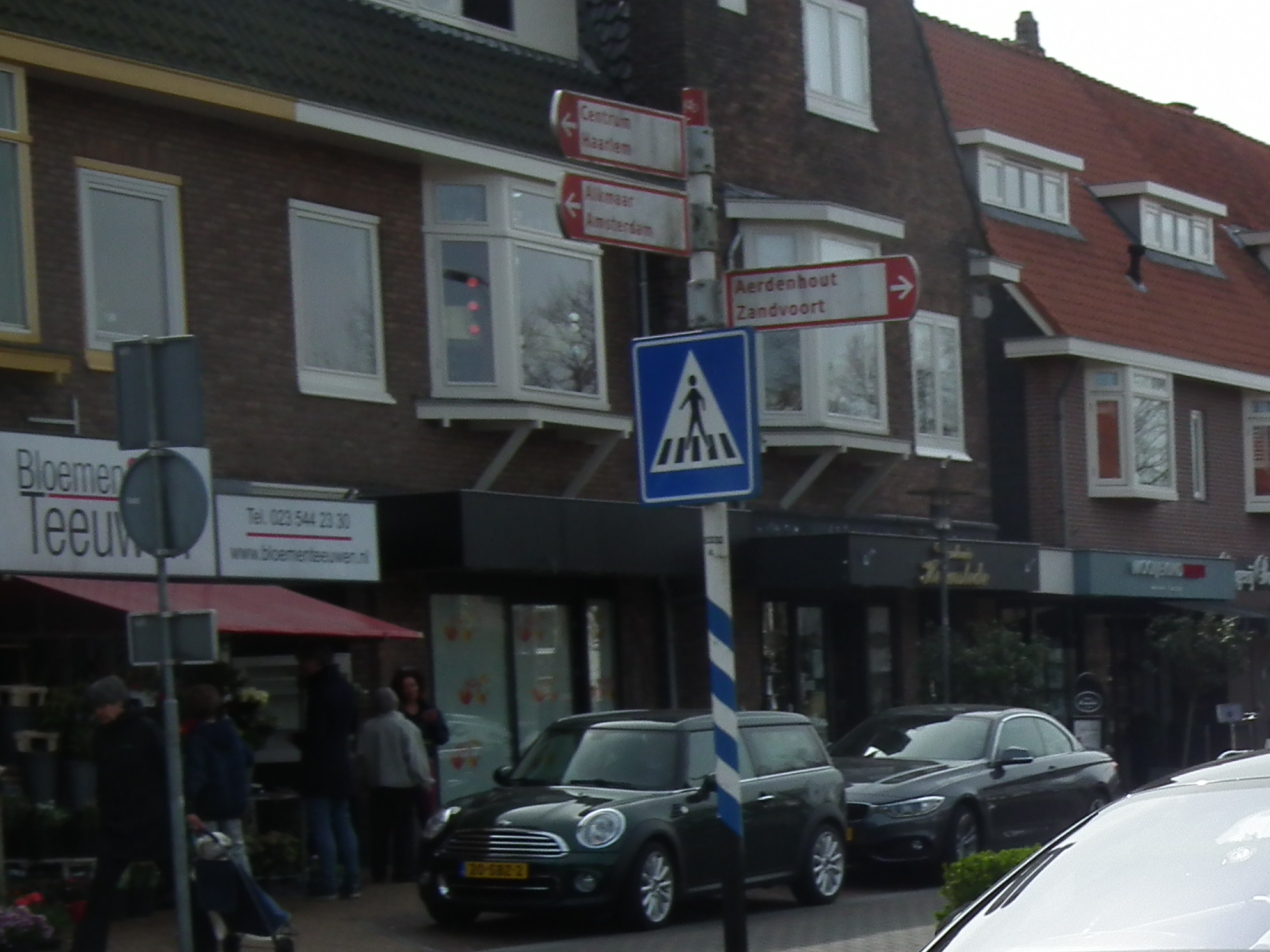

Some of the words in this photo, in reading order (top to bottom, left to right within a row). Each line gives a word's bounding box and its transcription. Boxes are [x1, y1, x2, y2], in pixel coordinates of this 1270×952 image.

[582, 104, 631, 129] Centrum
[583, 133, 632, 156] Haarlem
[585, 185, 634, 208] Alkmaar
[586, 213, 654, 237] Amsterdam
[735, 272, 838, 294] Aerdenhout
[737, 299, 826, 320] Zandvoort
[18, 448, 125, 494] Bloemen
